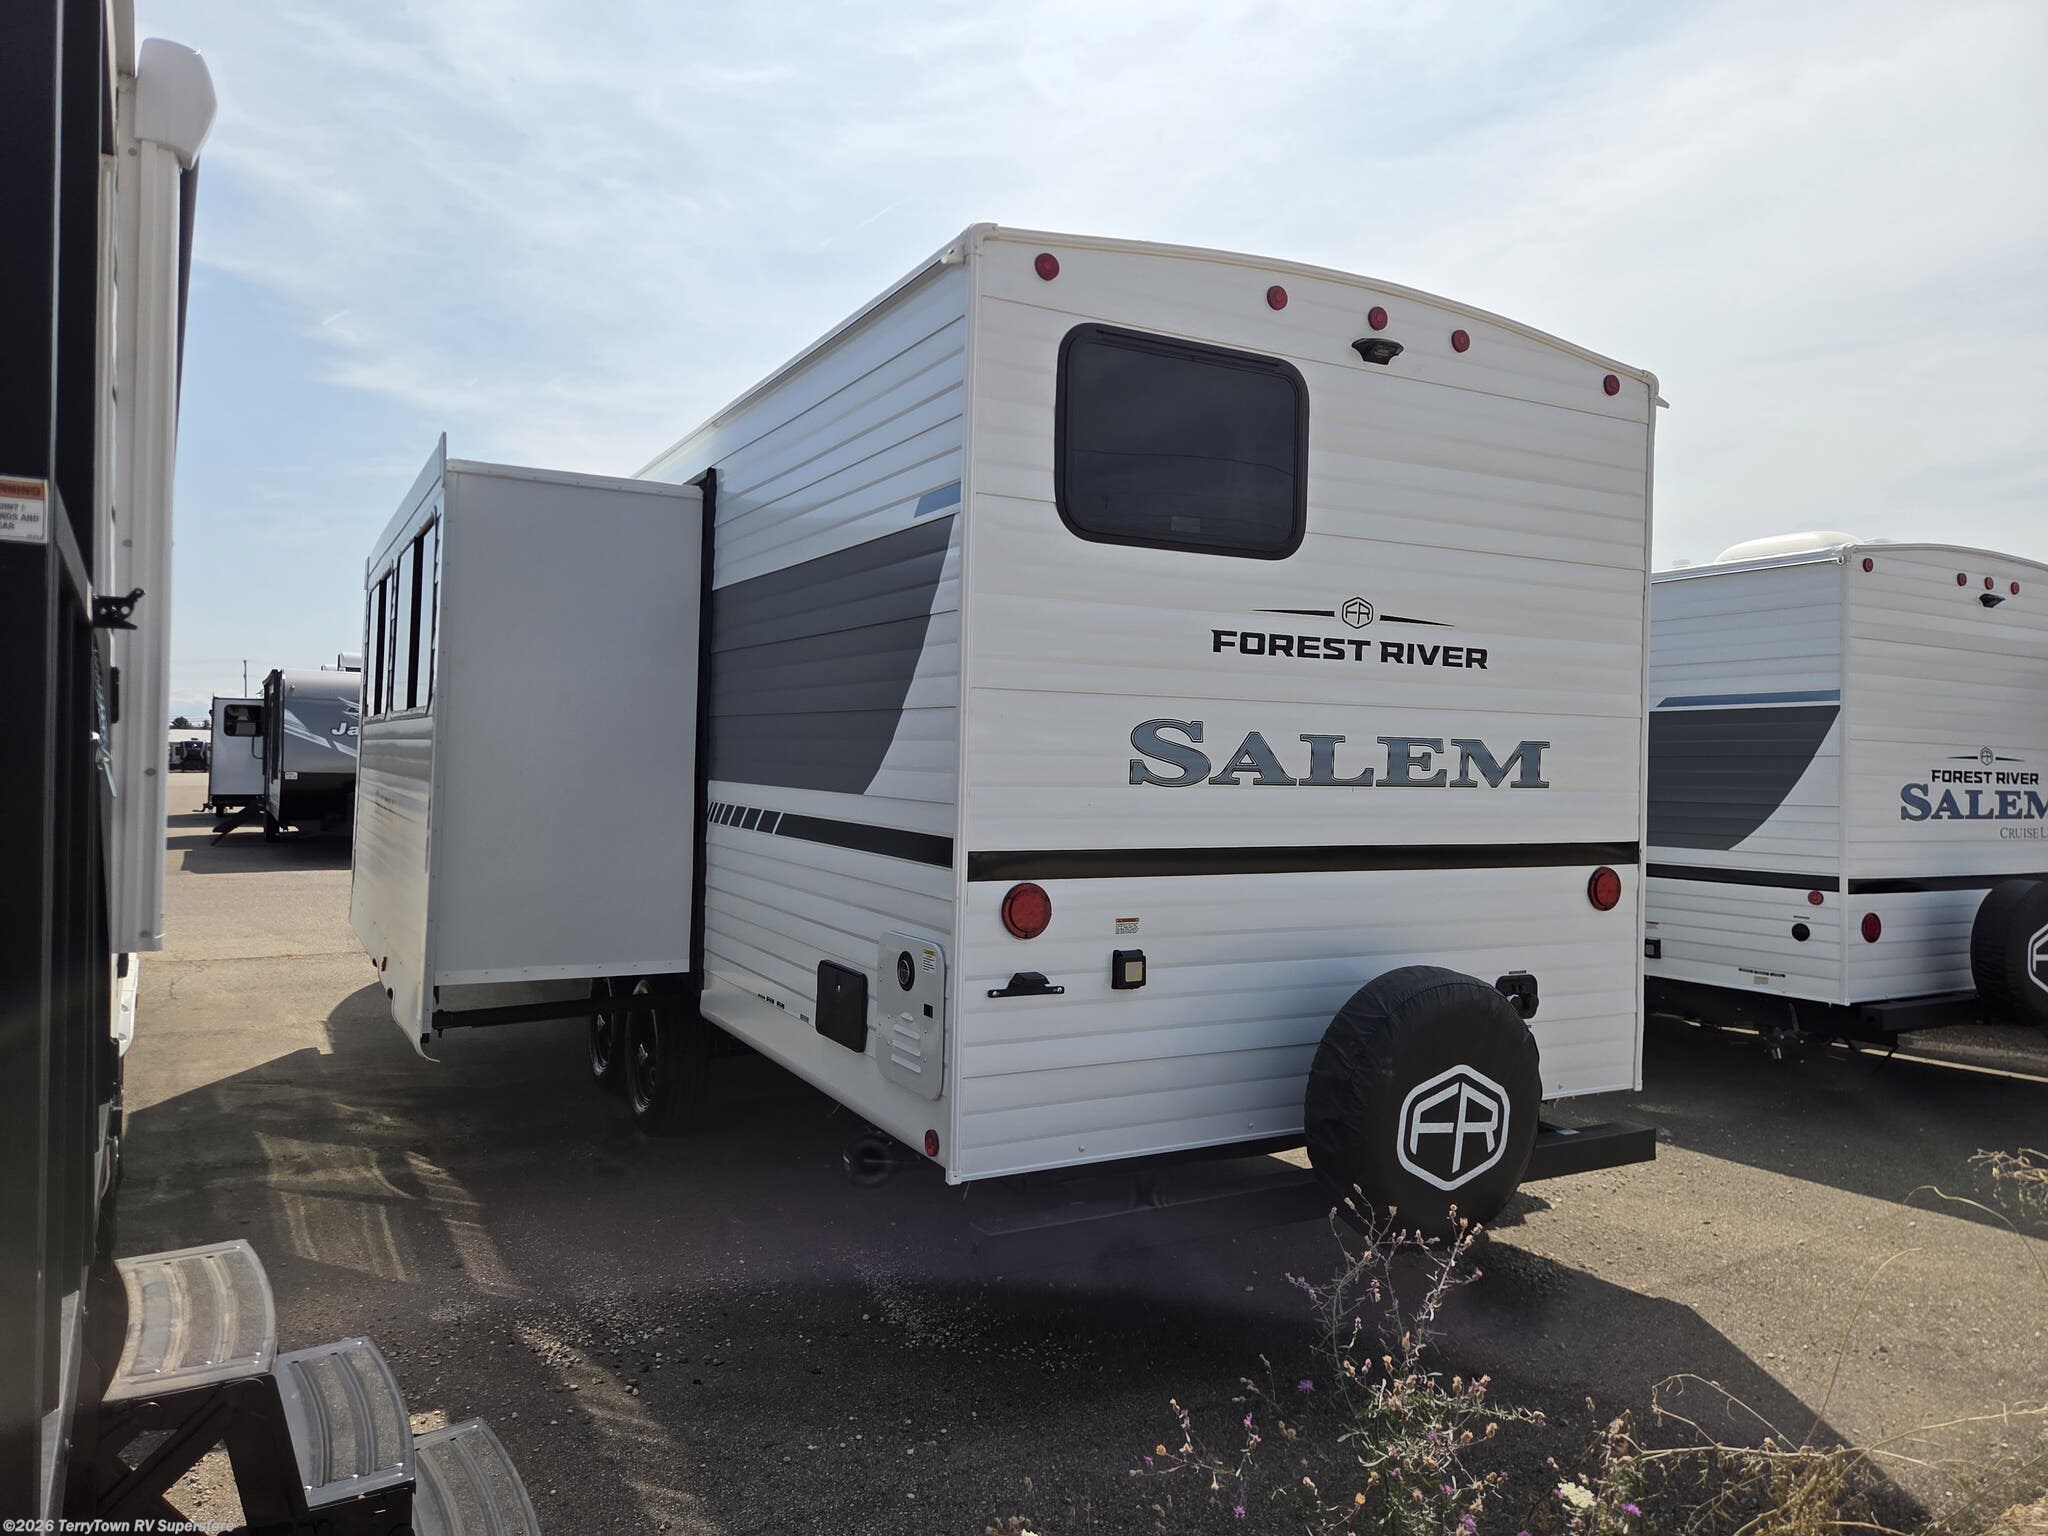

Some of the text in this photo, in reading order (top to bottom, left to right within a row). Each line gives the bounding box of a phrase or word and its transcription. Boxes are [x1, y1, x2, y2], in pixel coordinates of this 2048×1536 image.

[20, 513, 39, 522] AND
[1211, 629, 1488, 669] FOREST RIVER
[1129, 718, 1550, 788] SALEM
[1931, 769, 2039, 785] FOREST RIVER
[2000, 826, 2039, 839] CRUISE
